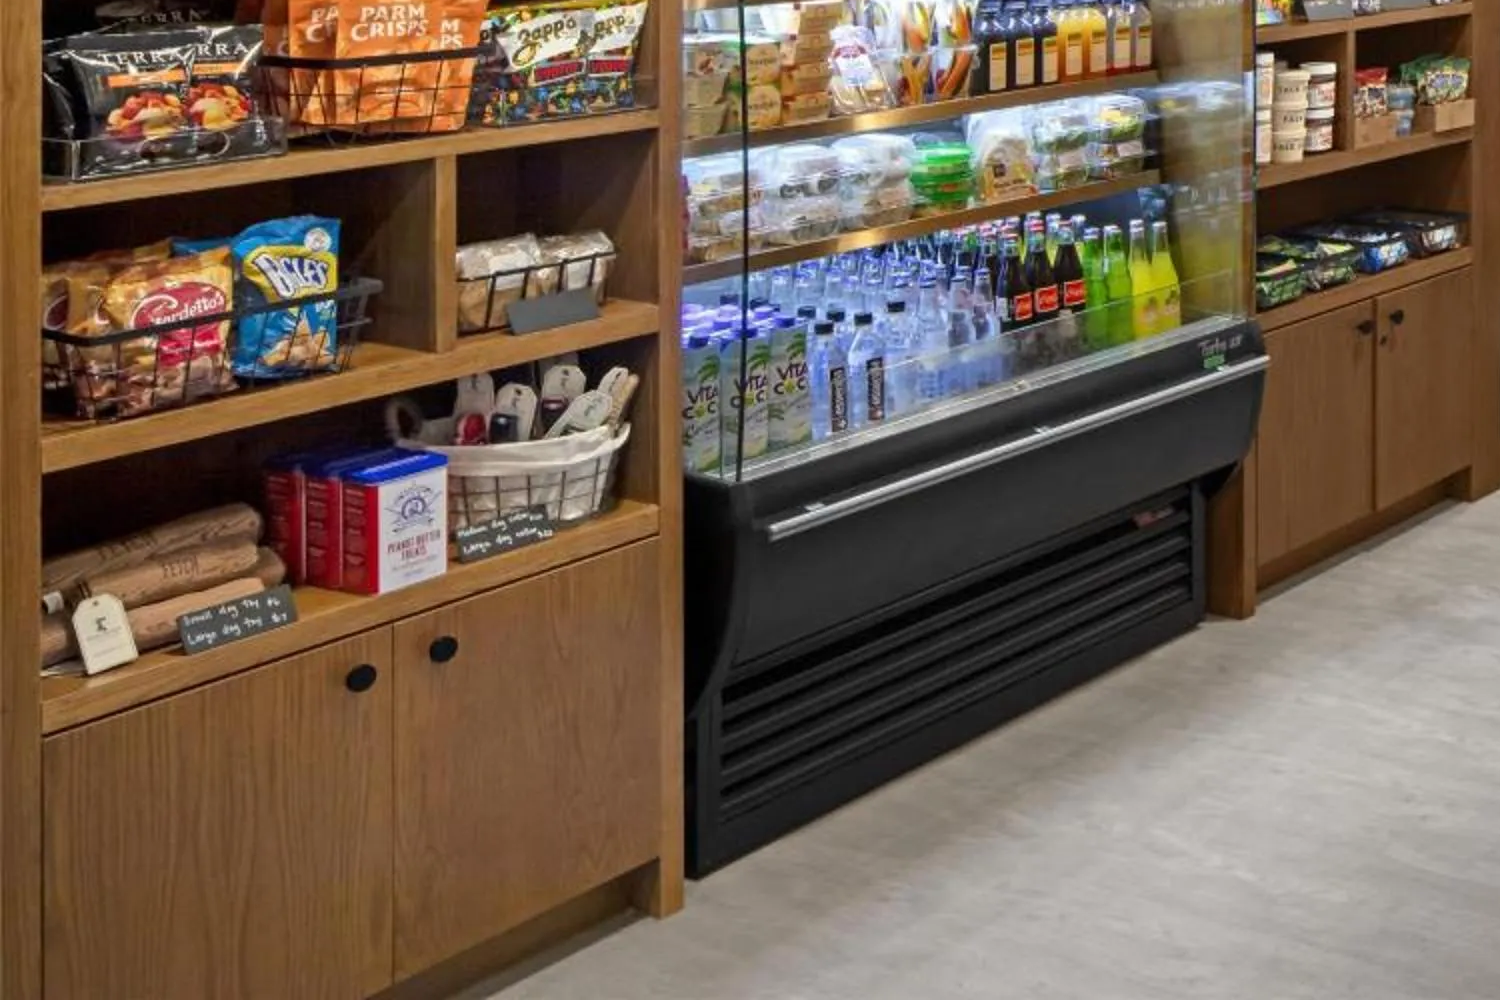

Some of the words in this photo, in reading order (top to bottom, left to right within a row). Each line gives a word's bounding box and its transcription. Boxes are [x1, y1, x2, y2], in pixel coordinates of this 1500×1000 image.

[140, 8, 203, 24] ERRA
[311, 6, 339, 22] PA
[359, 2, 426, 22] PARM
[351, 19, 429, 41] CRISPS
[512, 13, 577, 65] Zapp's
[101, 51, 184, 66] TERRA
[197, 42, 250, 57] RRA
[776, 361, 809, 380] VITA
[734, 374, 768, 392] VITA
[773, 376, 807, 395] COC
[686, 385, 719, 404] VITA
[729, 389, 765, 409] COC
[681, 401, 717, 420] COC
[387, 536, 415, 554] PEANUT
[416, 529, 441, 546] BUTTER
[463, 541, 492, 555] Large
[401, 545, 428, 562] TREATS
[161, 554, 199, 579] FETCH
[219, 605, 239, 619] dog
[187, 631, 217, 645] Large
[222, 624, 241, 636] dog
